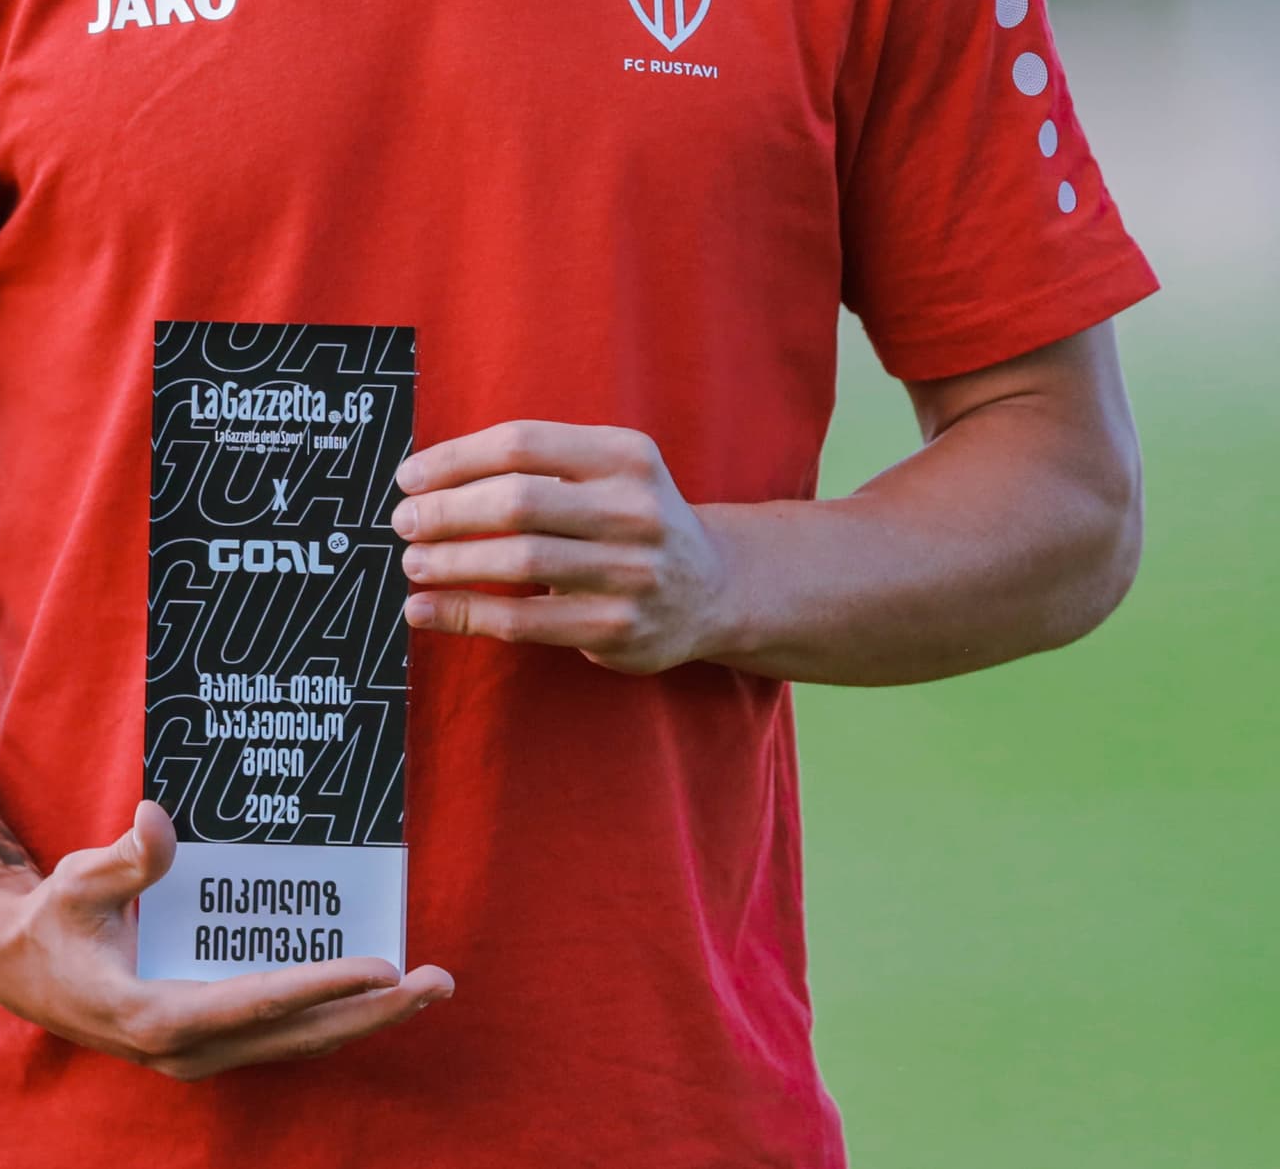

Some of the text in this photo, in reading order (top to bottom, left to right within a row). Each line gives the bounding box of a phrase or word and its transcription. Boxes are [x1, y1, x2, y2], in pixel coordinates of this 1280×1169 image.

[623, 58, 719, 79] FC RUSTAVI
[208, 538, 336, 575] GOAL
[199, 672, 352, 705] მაისის თვის
[205, 709, 344, 742] საუკეთესო
[242, 747, 305, 778] გოლი
[244, 793, 301, 824] 2026
[199, 877, 342, 916] ნიკოლოზ
[195, 924, 344, 963] ჩიქოვანი
